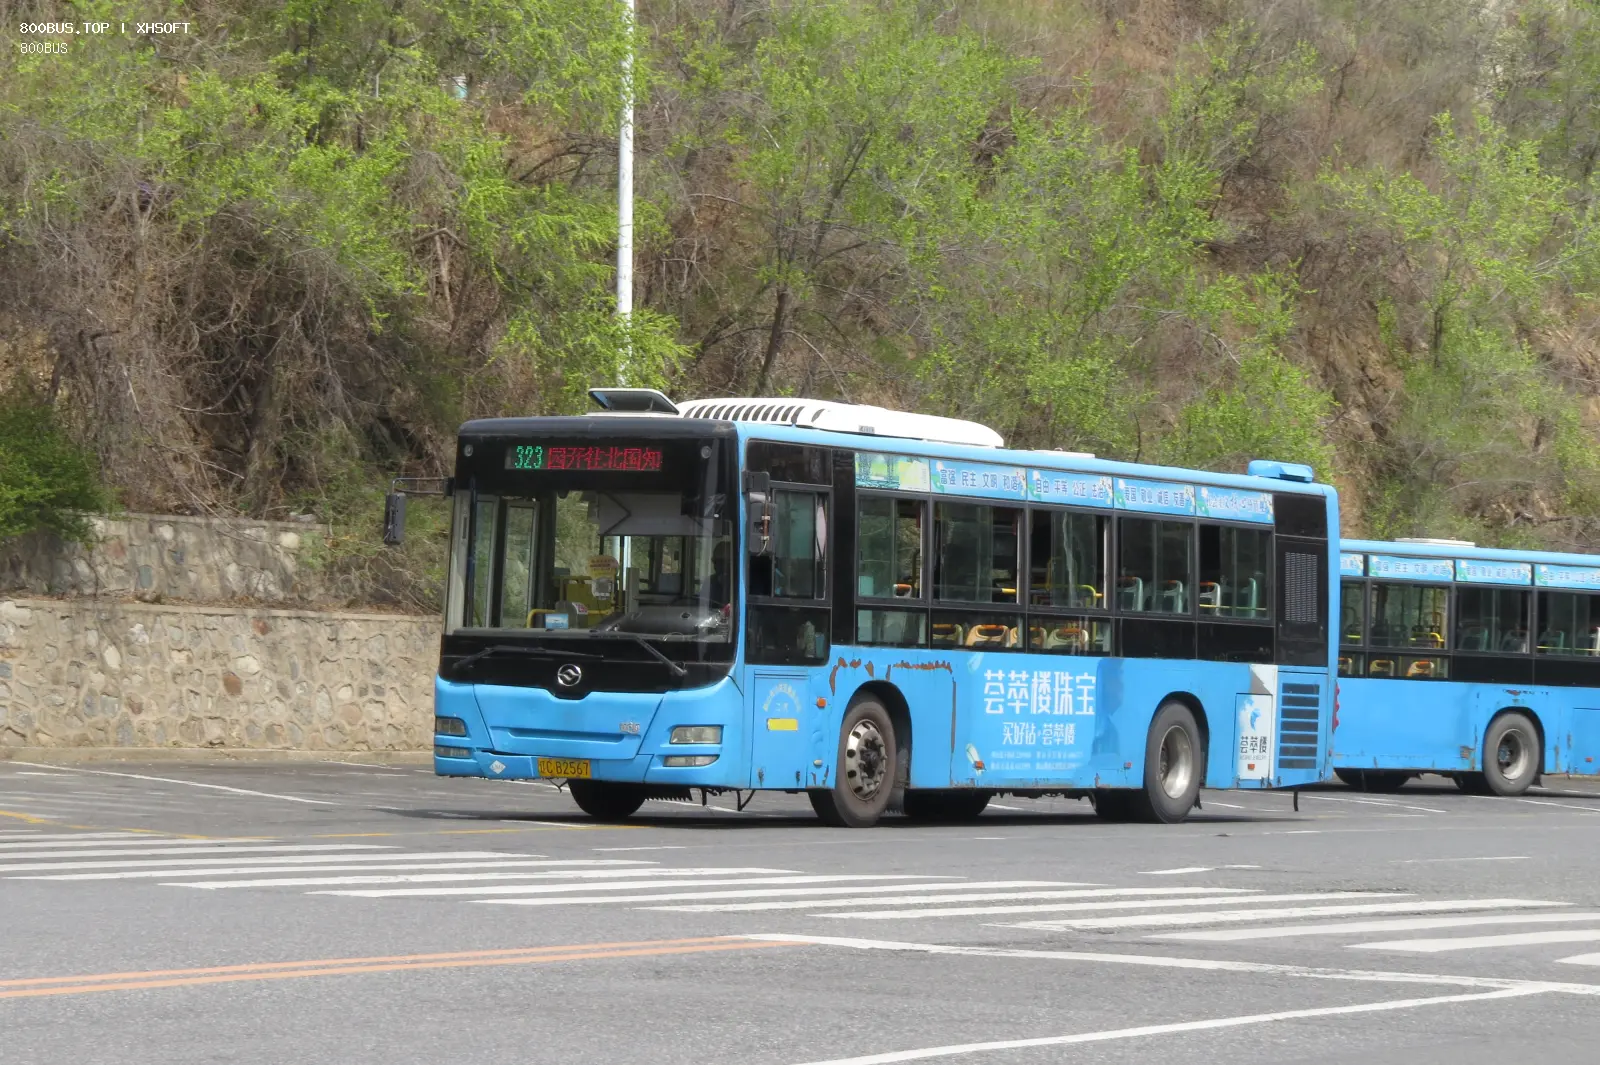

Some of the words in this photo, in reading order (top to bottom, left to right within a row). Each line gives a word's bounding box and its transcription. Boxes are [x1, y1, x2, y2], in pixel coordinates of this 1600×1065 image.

[515, 446, 543, 468] 323
[961, 471, 977, 488] 民主
[984, 669, 1096, 715] 荟萃楼珠宝
[1240, 736, 1267, 753] 荟萃楼
